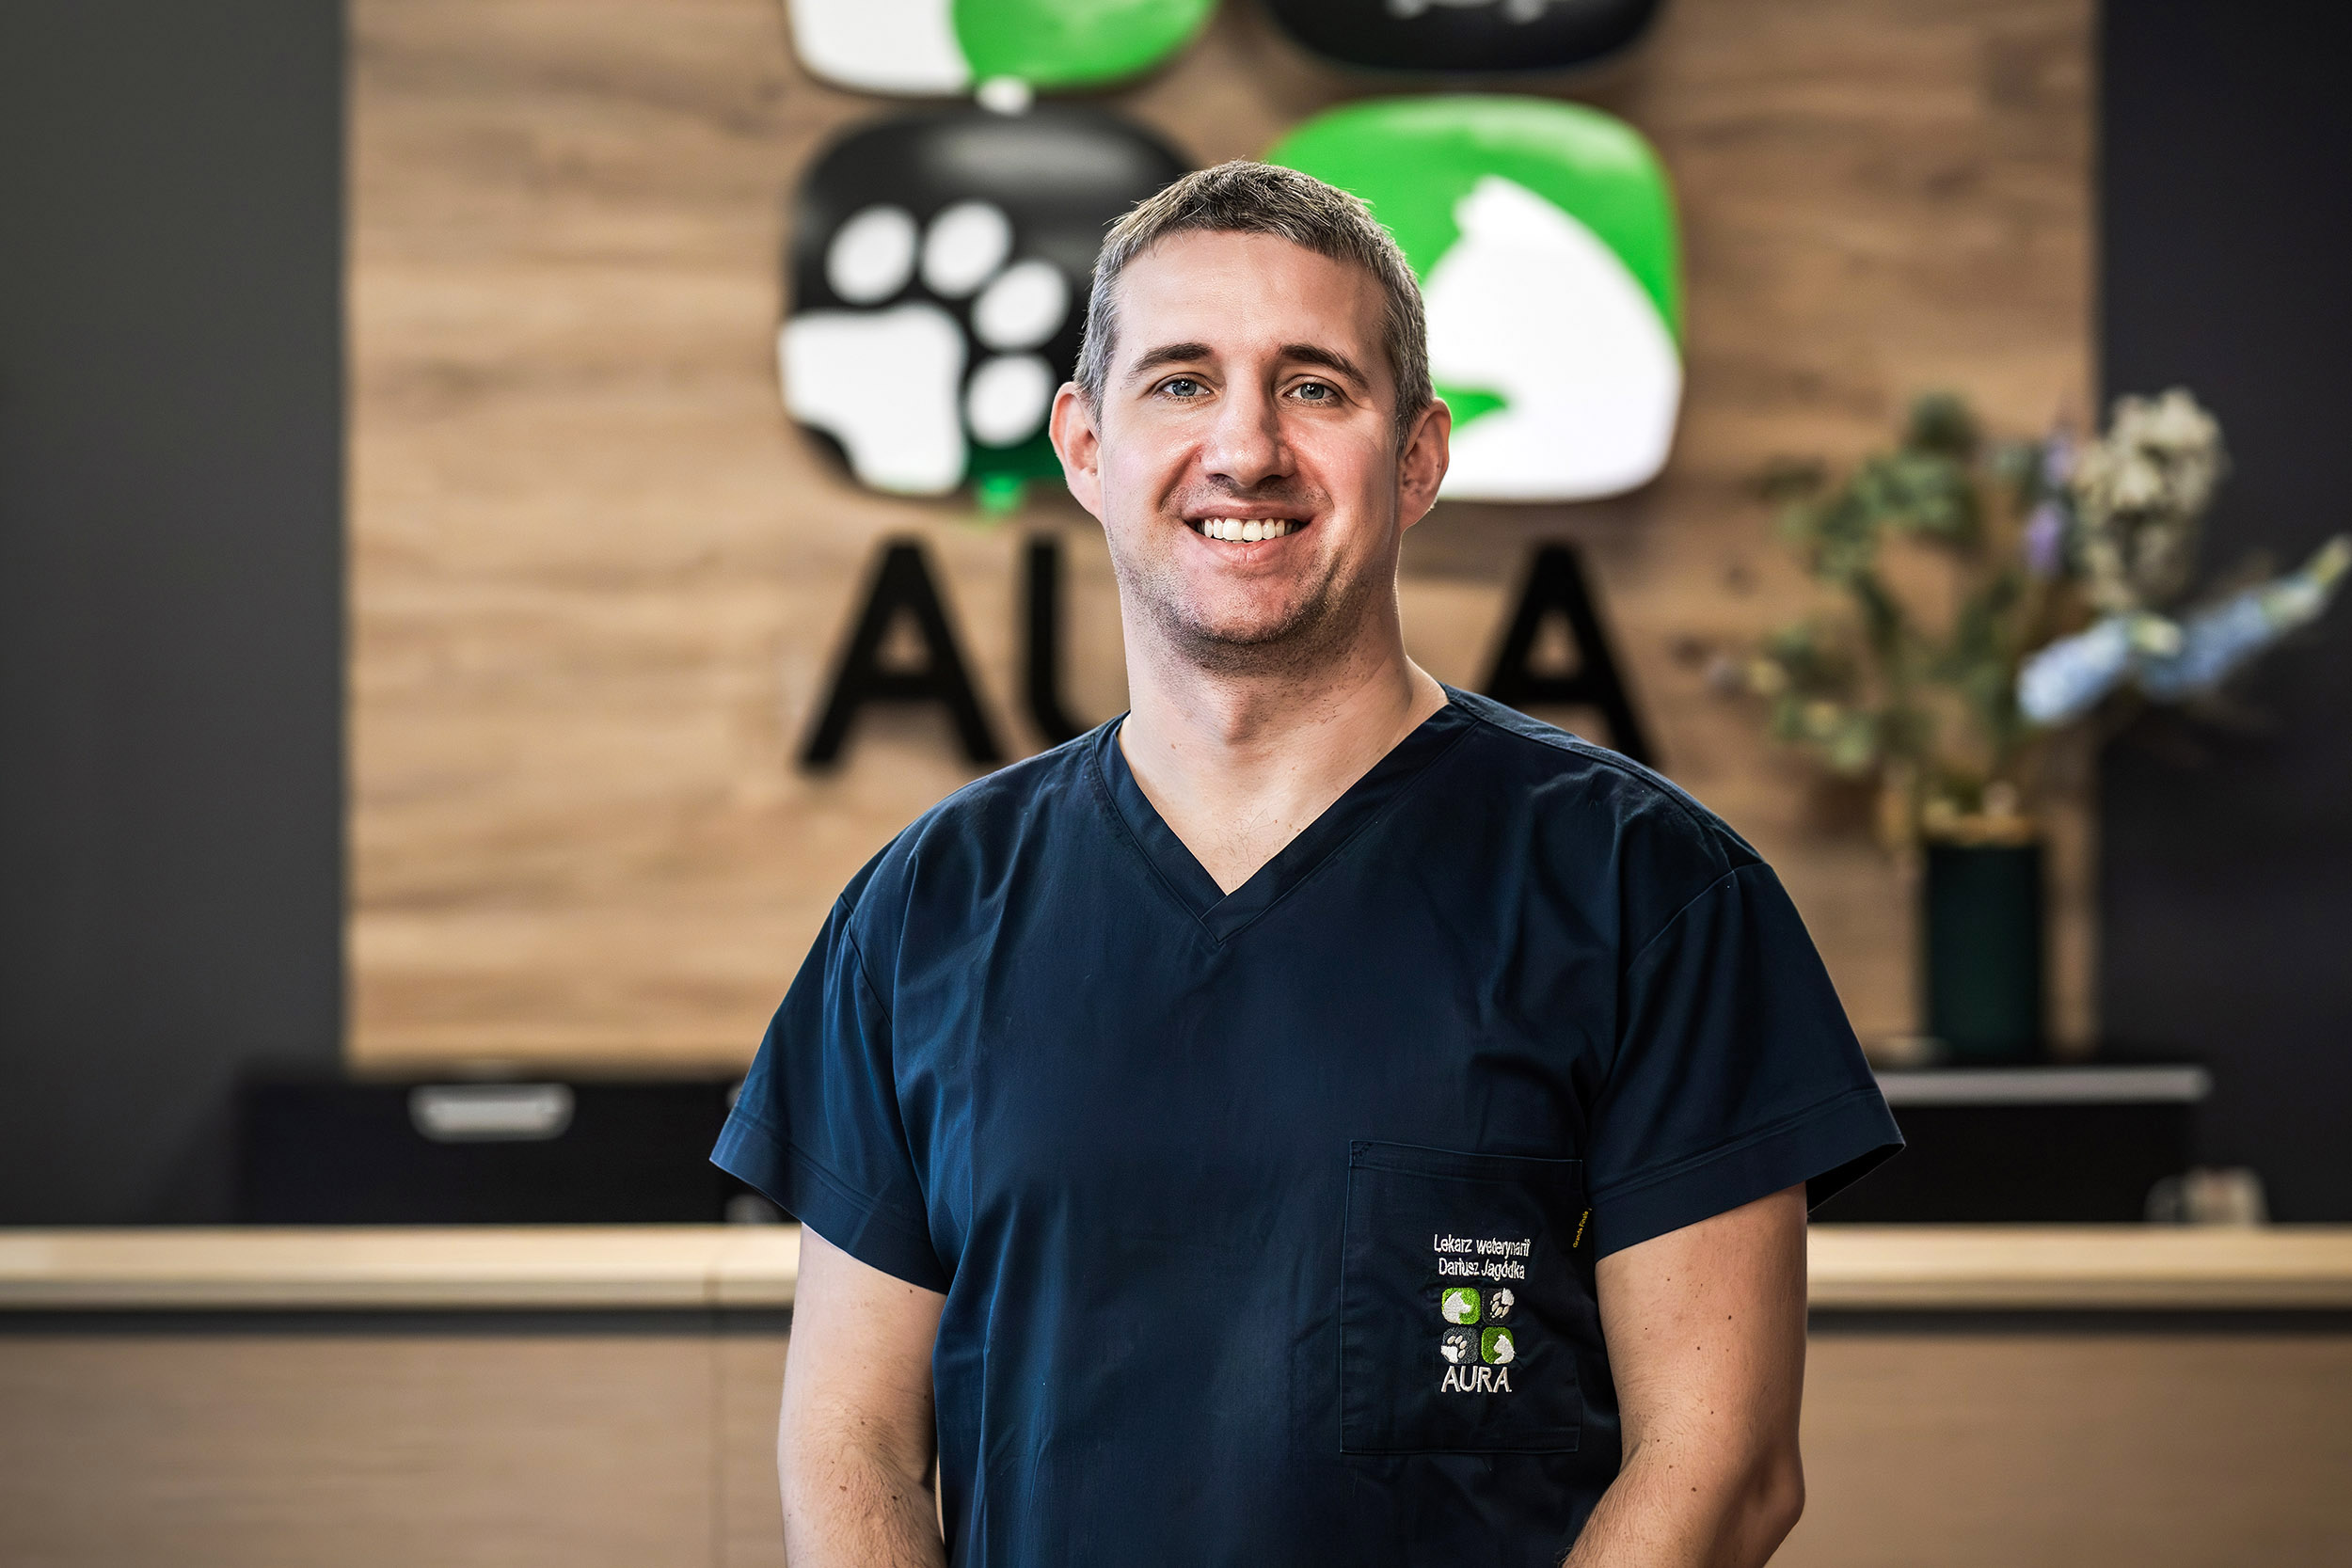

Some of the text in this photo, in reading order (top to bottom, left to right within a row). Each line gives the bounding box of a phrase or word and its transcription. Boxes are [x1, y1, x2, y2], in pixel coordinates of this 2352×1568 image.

[796, 533, 1667, 776] AA
[1433, 1233, 1532, 1259] Lekarz weterynarii
[1438, 1257, 1525, 1282] Dariusz Jagódka
[1440, 1365, 1512, 1393] AURA
